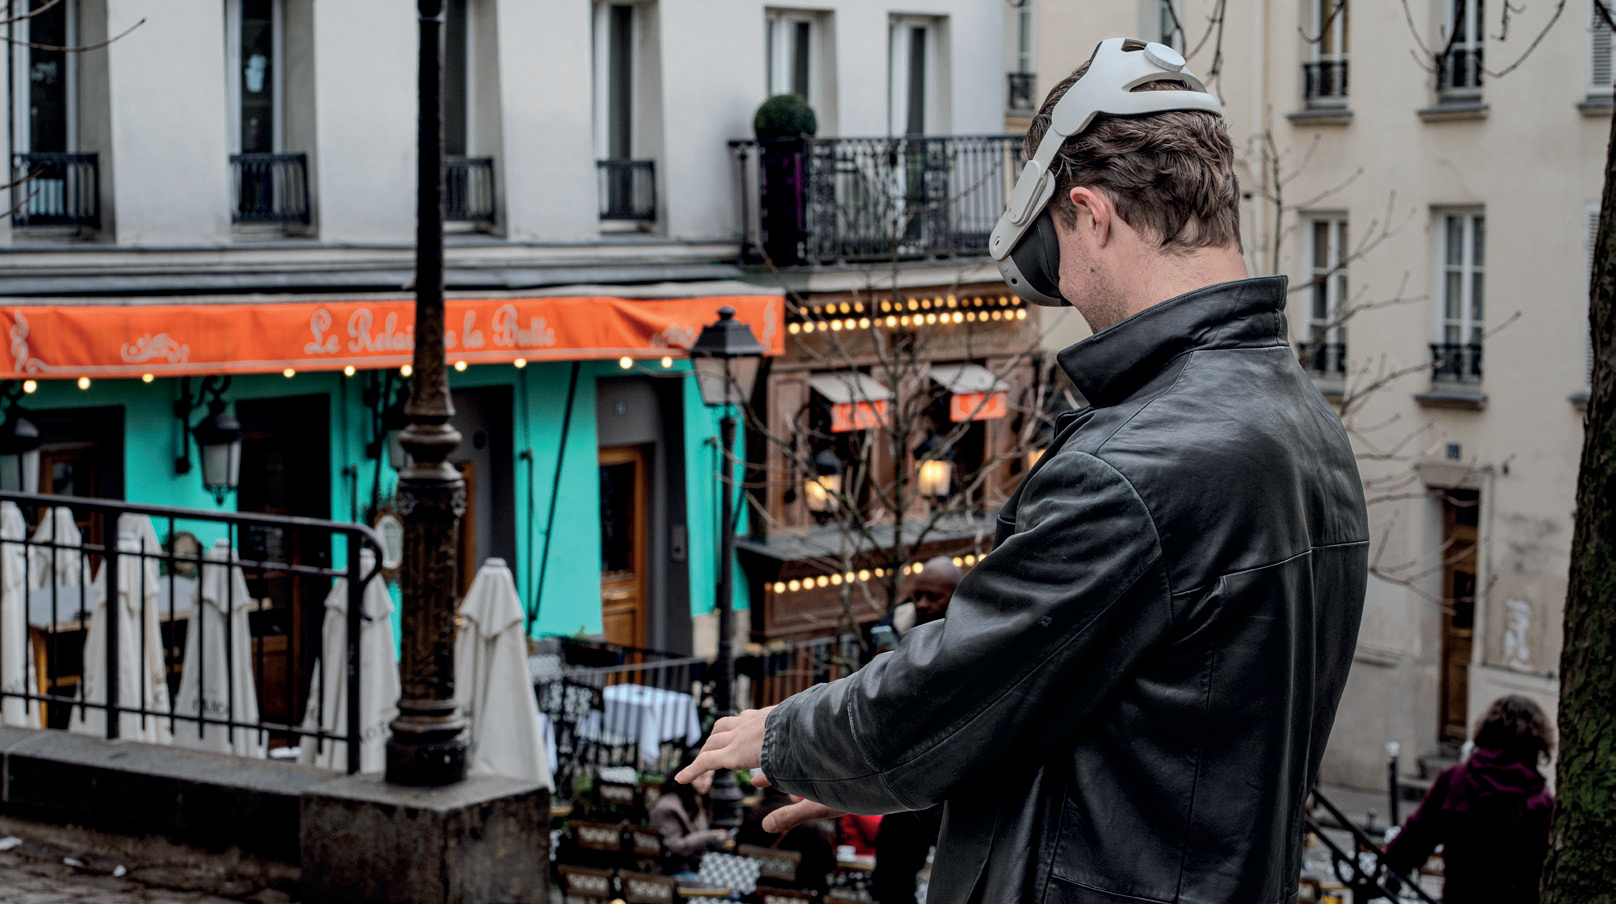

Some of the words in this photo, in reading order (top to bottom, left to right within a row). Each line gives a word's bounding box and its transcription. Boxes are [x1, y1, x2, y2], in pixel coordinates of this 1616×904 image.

[304, 308, 340, 354] Le
[347, 308, 416, 353] Relai
[462, 310, 486, 349] la
